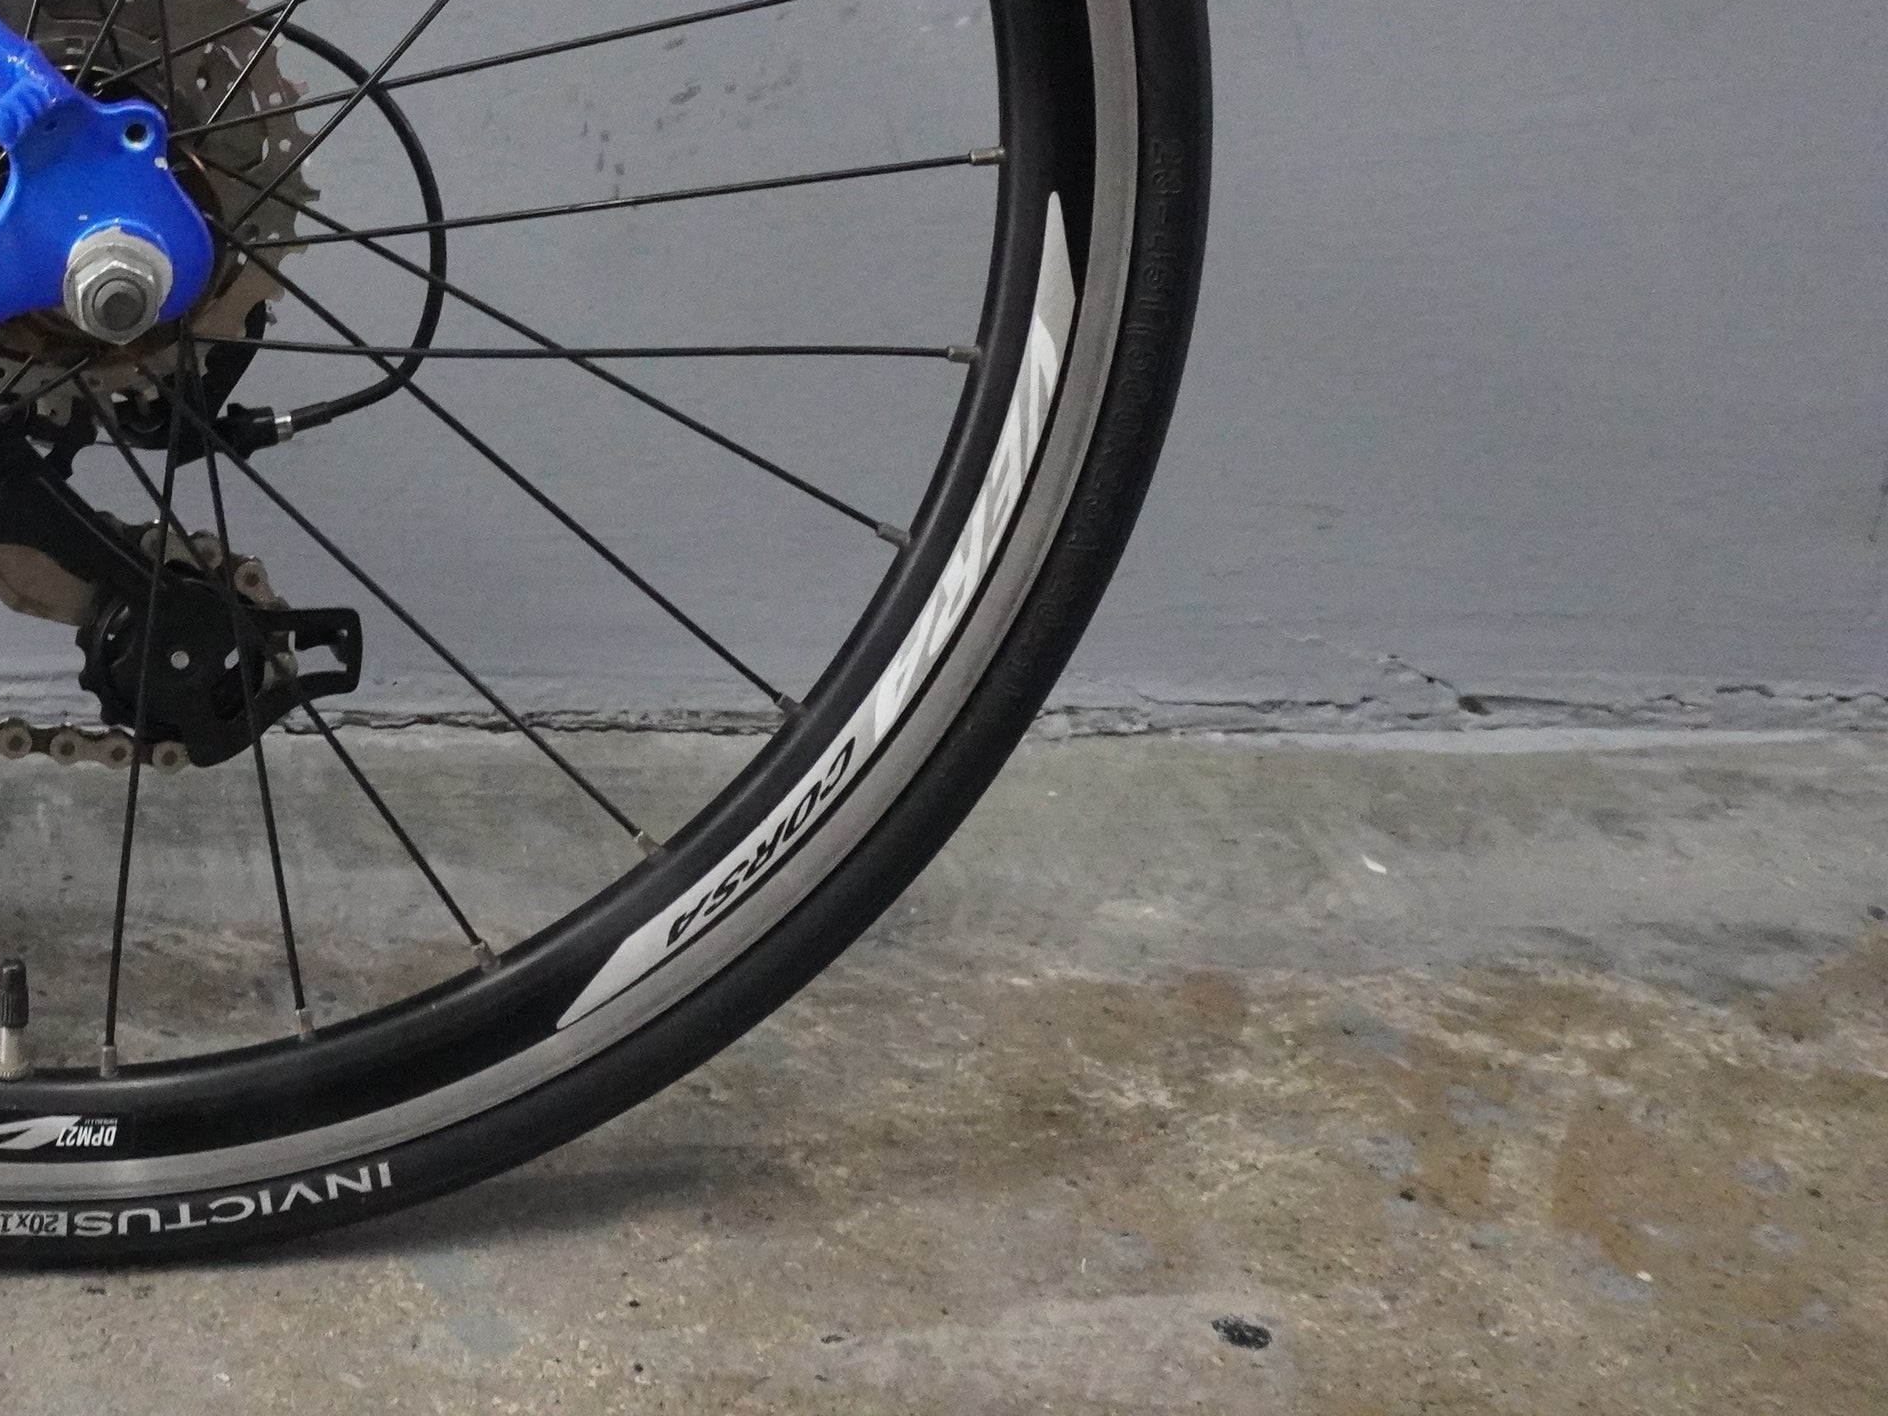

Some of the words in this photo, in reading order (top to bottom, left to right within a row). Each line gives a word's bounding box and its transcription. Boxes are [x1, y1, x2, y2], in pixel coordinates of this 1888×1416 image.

[665, 735, 858, 948] CORSA
[55, 1124, 118, 1149] DPM27
[0, 1212, 60, 1235] 20x1
[73, 1160, 393, 1237] INVICTUS
